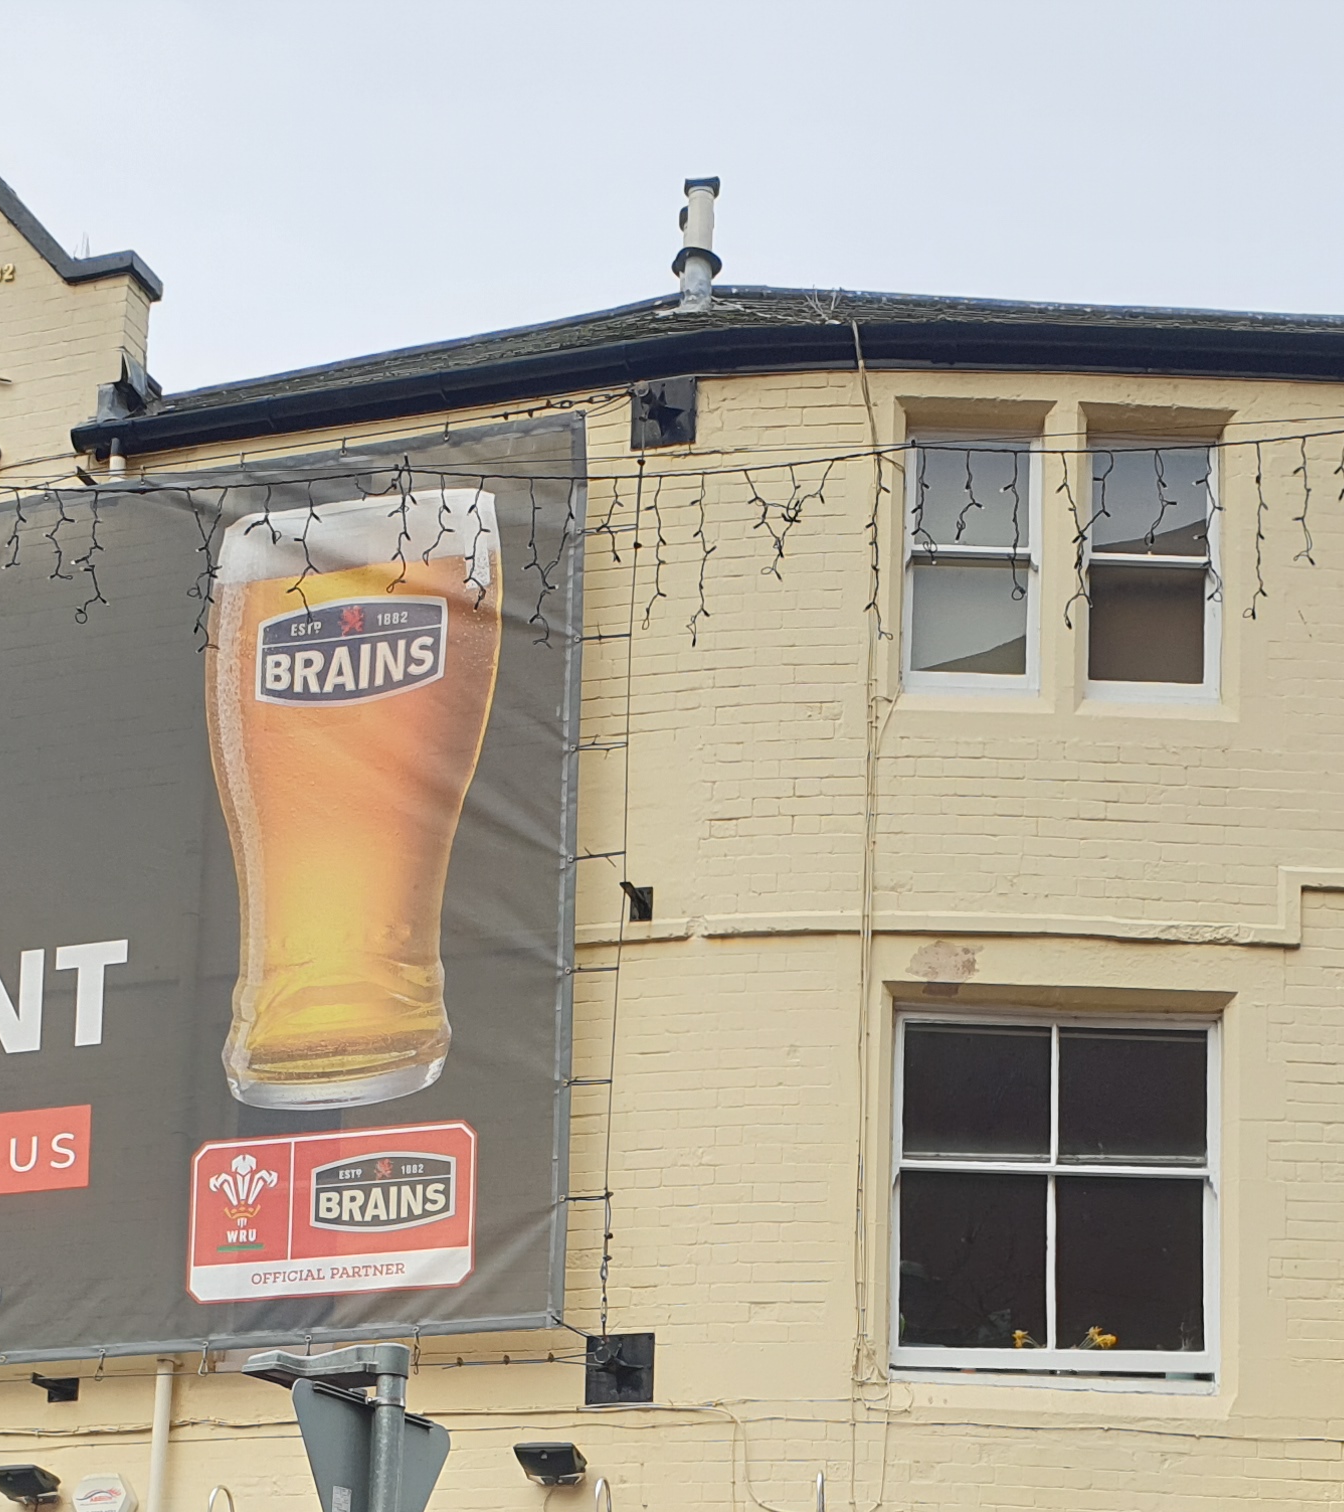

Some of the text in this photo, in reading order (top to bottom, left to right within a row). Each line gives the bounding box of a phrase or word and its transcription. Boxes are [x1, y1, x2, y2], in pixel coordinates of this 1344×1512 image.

[376, 611, 409, 626] 1882
[265, 635, 436, 694] BRAINS
[9, 1132, 77, 1174] US
[400, 1163, 424, 1175] 1882
[319, 1183, 446, 1222] BRAINS
[226, 1229, 257, 1244] WRU
[250, 1262, 406, 1286] OFFICIAL PARTNER
